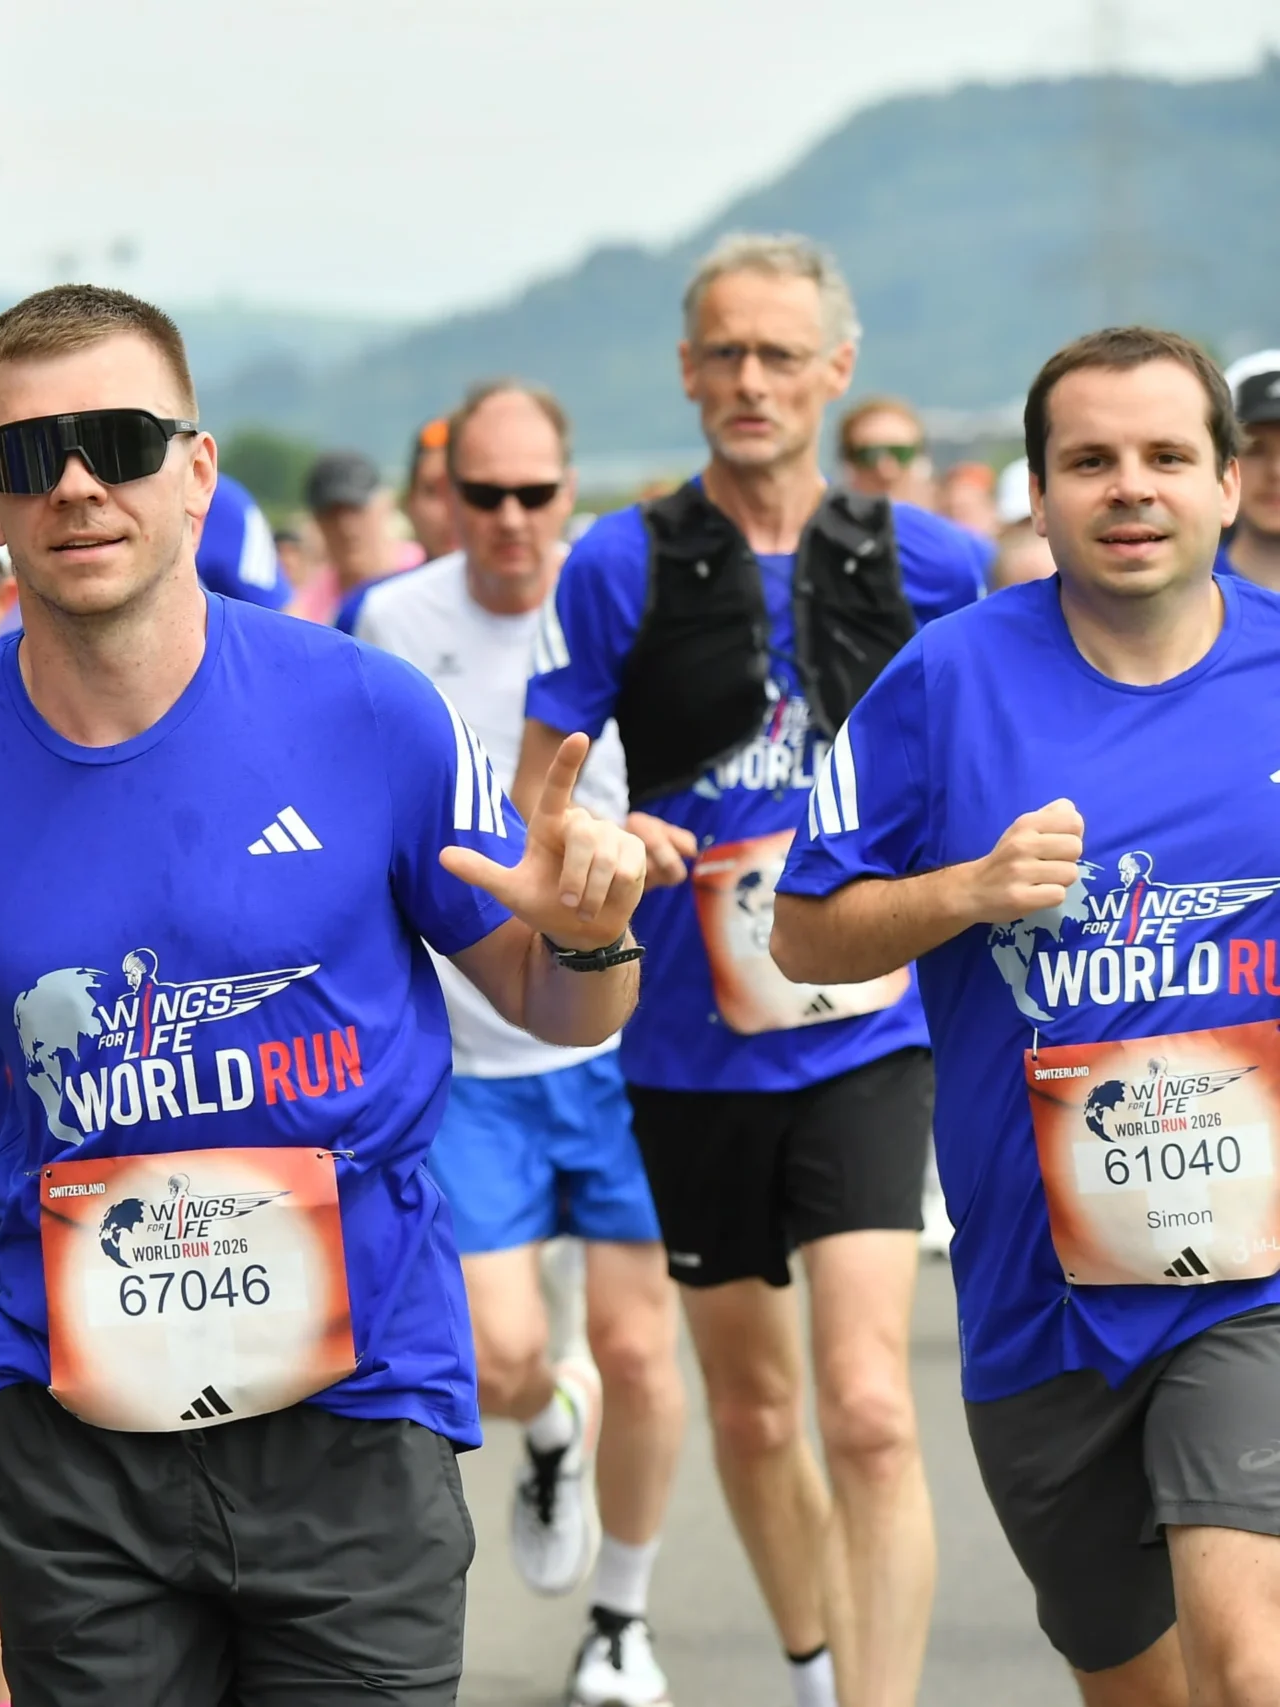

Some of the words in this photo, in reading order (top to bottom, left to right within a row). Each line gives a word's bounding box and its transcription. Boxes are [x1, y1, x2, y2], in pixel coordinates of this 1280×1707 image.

[1089, 881, 1220, 921] WINGS
[1082, 921, 1109, 935] FOR
[1104, 917, 1183, 947] LIFE
[1038, 941, 1220, 1008] WORLD
[1228, 939, 1280, 996] RU
[98, 983, 233, 1031] WINGS
[98, 1031, 123, 1050] FOR
[124, 1020, 198, 1061] LIFE
[65, 1048, 256, 1133] WORLD
[258, 1025, 365, 1106] RUN
[1034, 1066, 1090, 1081] SWITZERLAND
[1131, 1076, 1210, 1101] WINGS
[1127, 1102, 1144, 1110] FOR
[1144, 1096, 1190, 1118] LIFE
[1115, 1119, 1160, 1137] WORLD
[1161, 1117, 1187, 1133] RUN
[1191, 1112, 1222, 1129] 2026
[1104, 1135, 1241, 1185] 61040
[49, 1183, 106, 1199] SWITZERLAND
[150, 1195, 236, 1222] WINGS
[1147, 1209, 1213, 1229] Simon
[147, 1223, 164, 1233] FOR
[164, 1219, 212, 1241] LIFE
[132, 1243, 181, 1262] WORLD
[182, 1241, 210, 1259] RUN
[213, 1238, 248, 1256] 2026
[119, 1264, 271, 1317] 67046
